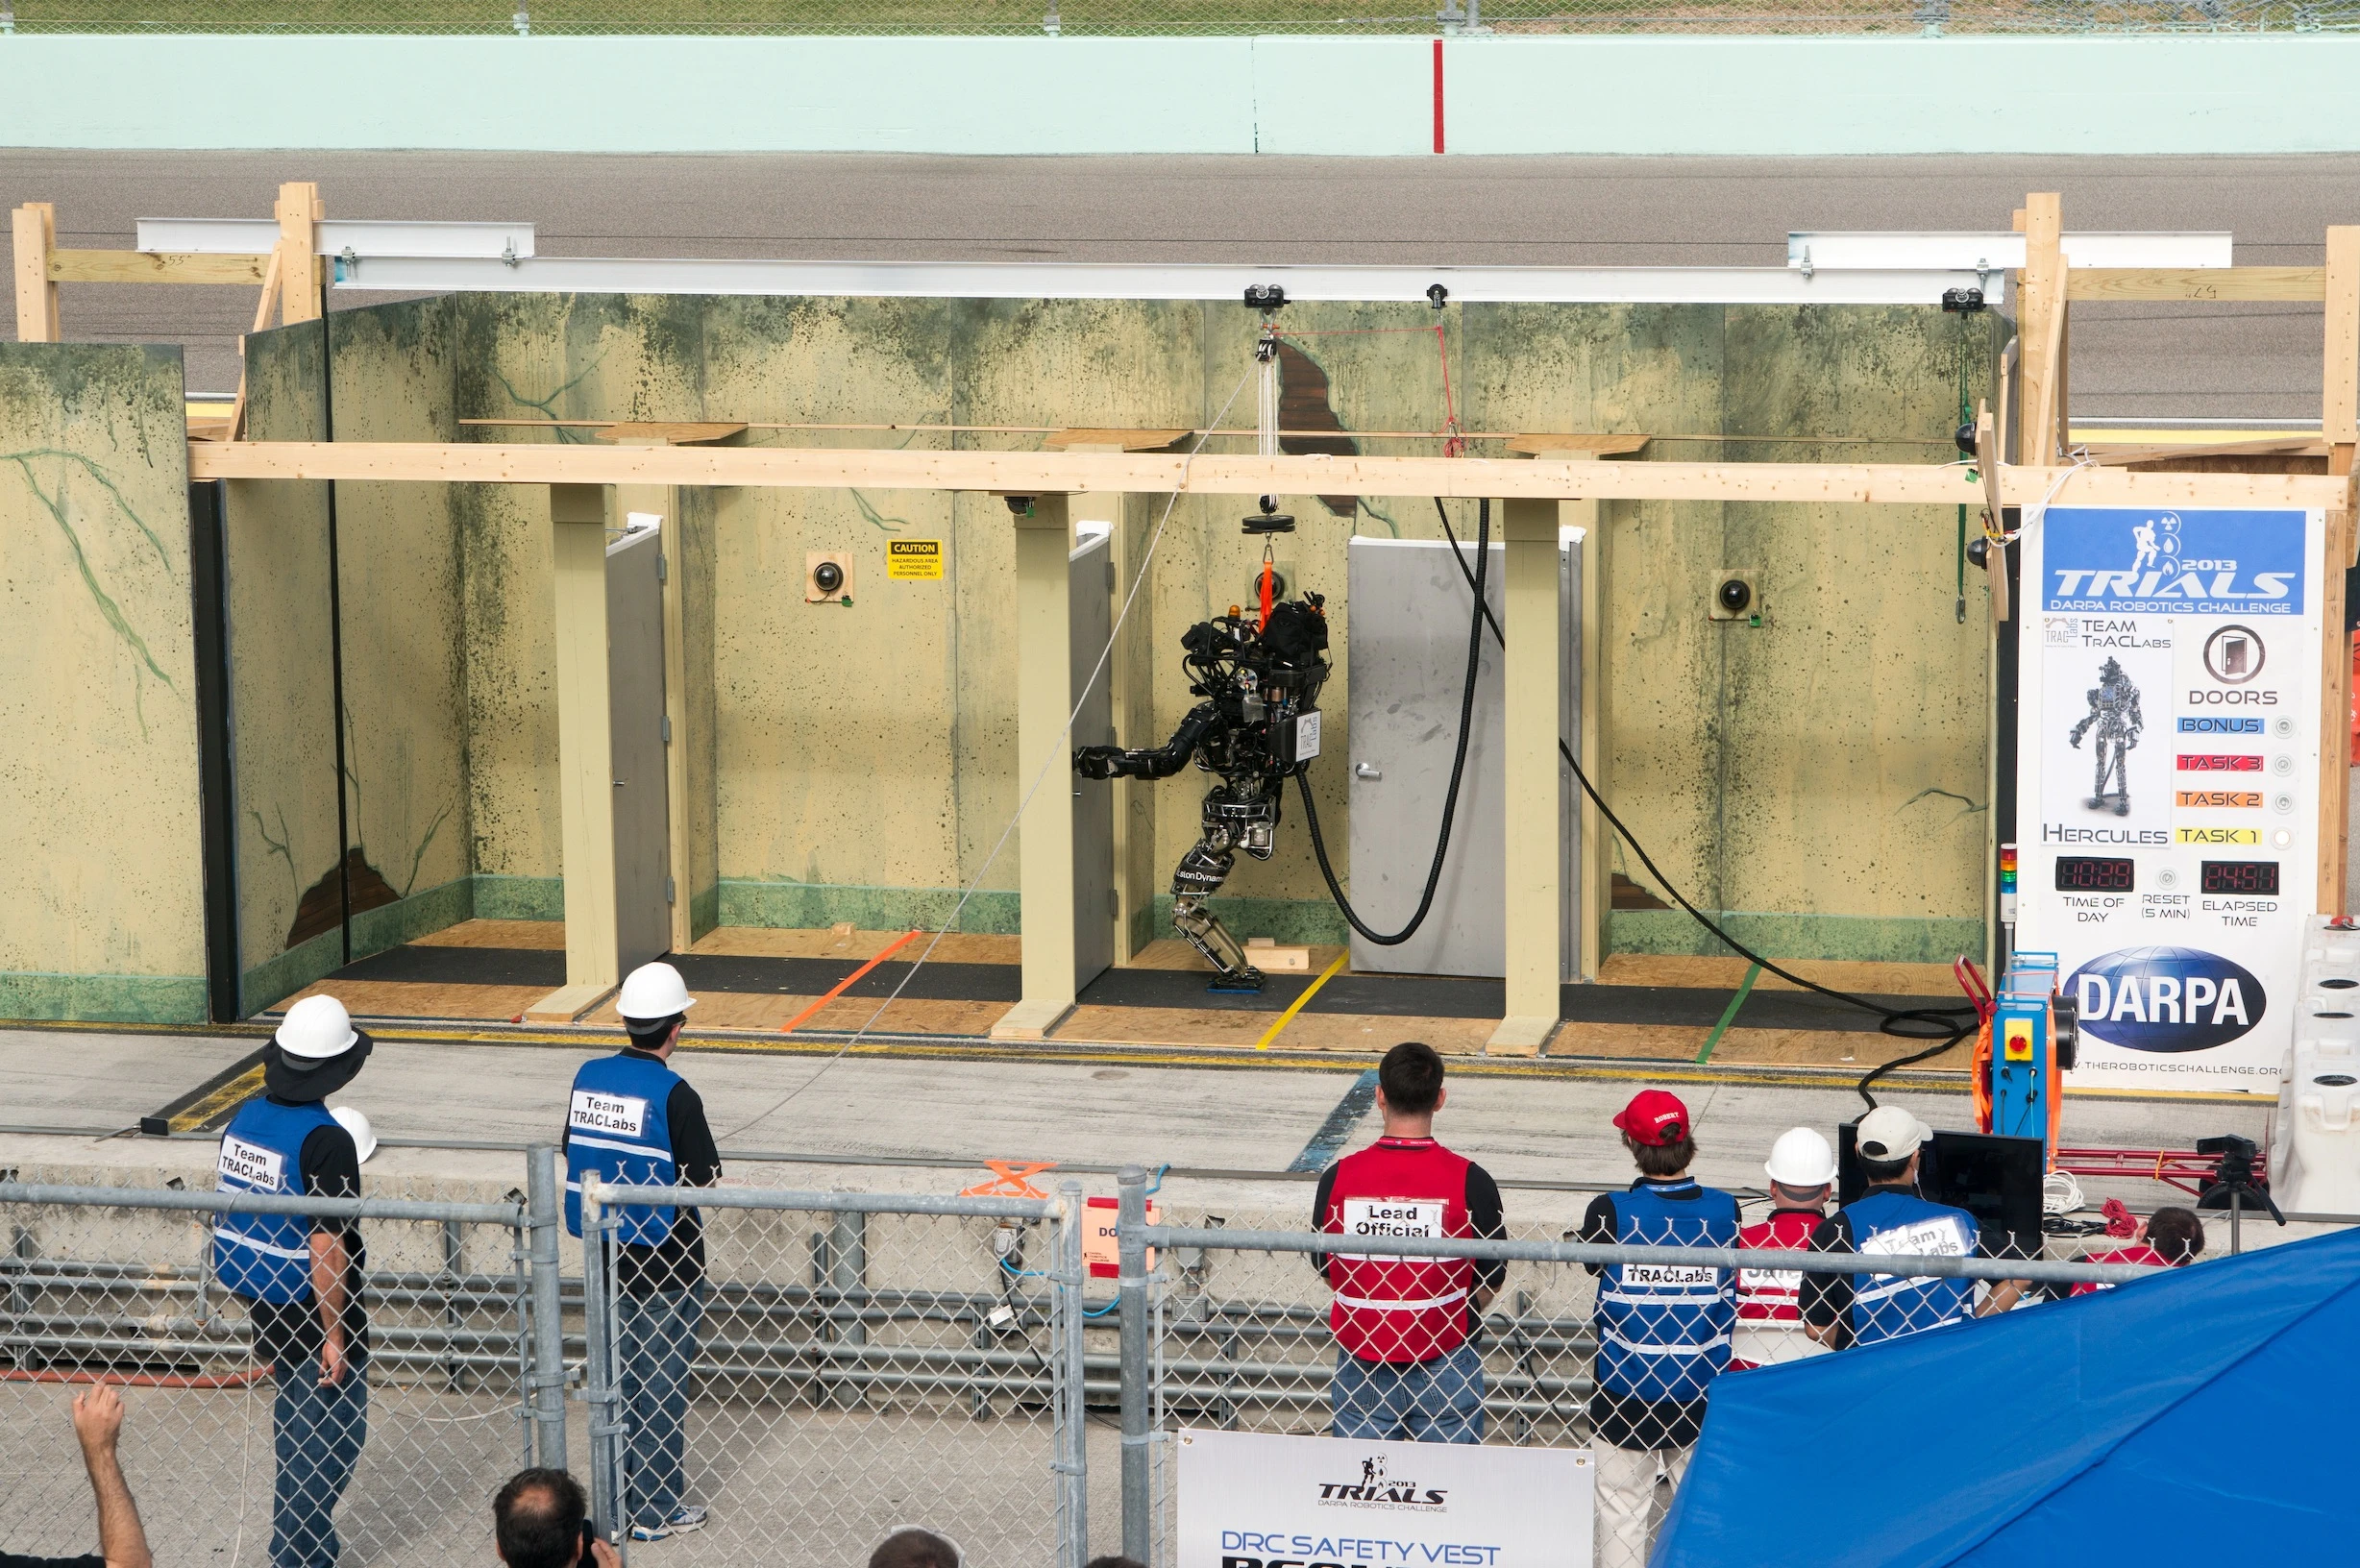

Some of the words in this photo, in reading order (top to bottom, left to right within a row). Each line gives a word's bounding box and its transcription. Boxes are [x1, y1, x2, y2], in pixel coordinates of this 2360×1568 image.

[894, 544, 935, 552] CAUTION
[2181, 559, 2237, 571] 2013
[2054, 569, 2296, 600] TRIALS
[2051, 600, 2106, 611] DARPA
[2109, 600, 2194, 613] ROBOTICS
[2198, 601, 2291, 614] CHALLENGE
[2081, 620, 2137, 632] TEAM
[2046, 630, 2069, 643] TRAC
[2189, 690, 2278, 705] DOORS
[2181, 719, 2259, 733] BONUS
[2181, 756, 2241, 771] TASK
[2247, 756, 2262, 772] 3
[2180, 792, 2240, 806] TASK
[2247, 793, 2260, 807] 2
[2180, 829, 2240, 843] TASK
[2250, 830, 2257, 843] 1
[2063, 896, 2100, 907] TIME
[2103, 897, 2125, 908] OF
[2142, 894, 2191, 905] RESET
[2202, 900, 2277, 912] ELAPSED
[2077, 912, 2109, 923] DAY
[2141, 907, 2156, 919] (5
[2159, 908, 2191, 919] MIN)
[2221, 916, 2258, 927] TIME
[2078, 973, 2249, 1026] DARPA
[2074, 1061, 2282, 1076] .THEROBOTICSCHALLENGE.OR
[586, 1096, 625, 1115] Team
[574, 1110, 637, 1132] TRACLabs
[1654, 1112, 1680, 1124] ROBERT
[234, 1143, 267, 1166] Team
[222, 1155, 275, 1187] TRACLabs
[1368, 1205, 1417, 1220] Lead
[1356, 1221, 1430, 1237] Official
[1628, 1268, 1712, 1284] TRACLabs
[1318, 1483, 1448, 1505] TRIALS
[1350, 1501, 1395, 1510] ROBOTICS
[1398, 1504, 1448, 1513] CHALLENGE
[1221, 1531, 1285, 1554] DRC
[1291, 1535, 1415, 1561] SAFETY
[1419, 1542, 1501, 1566] VEST
